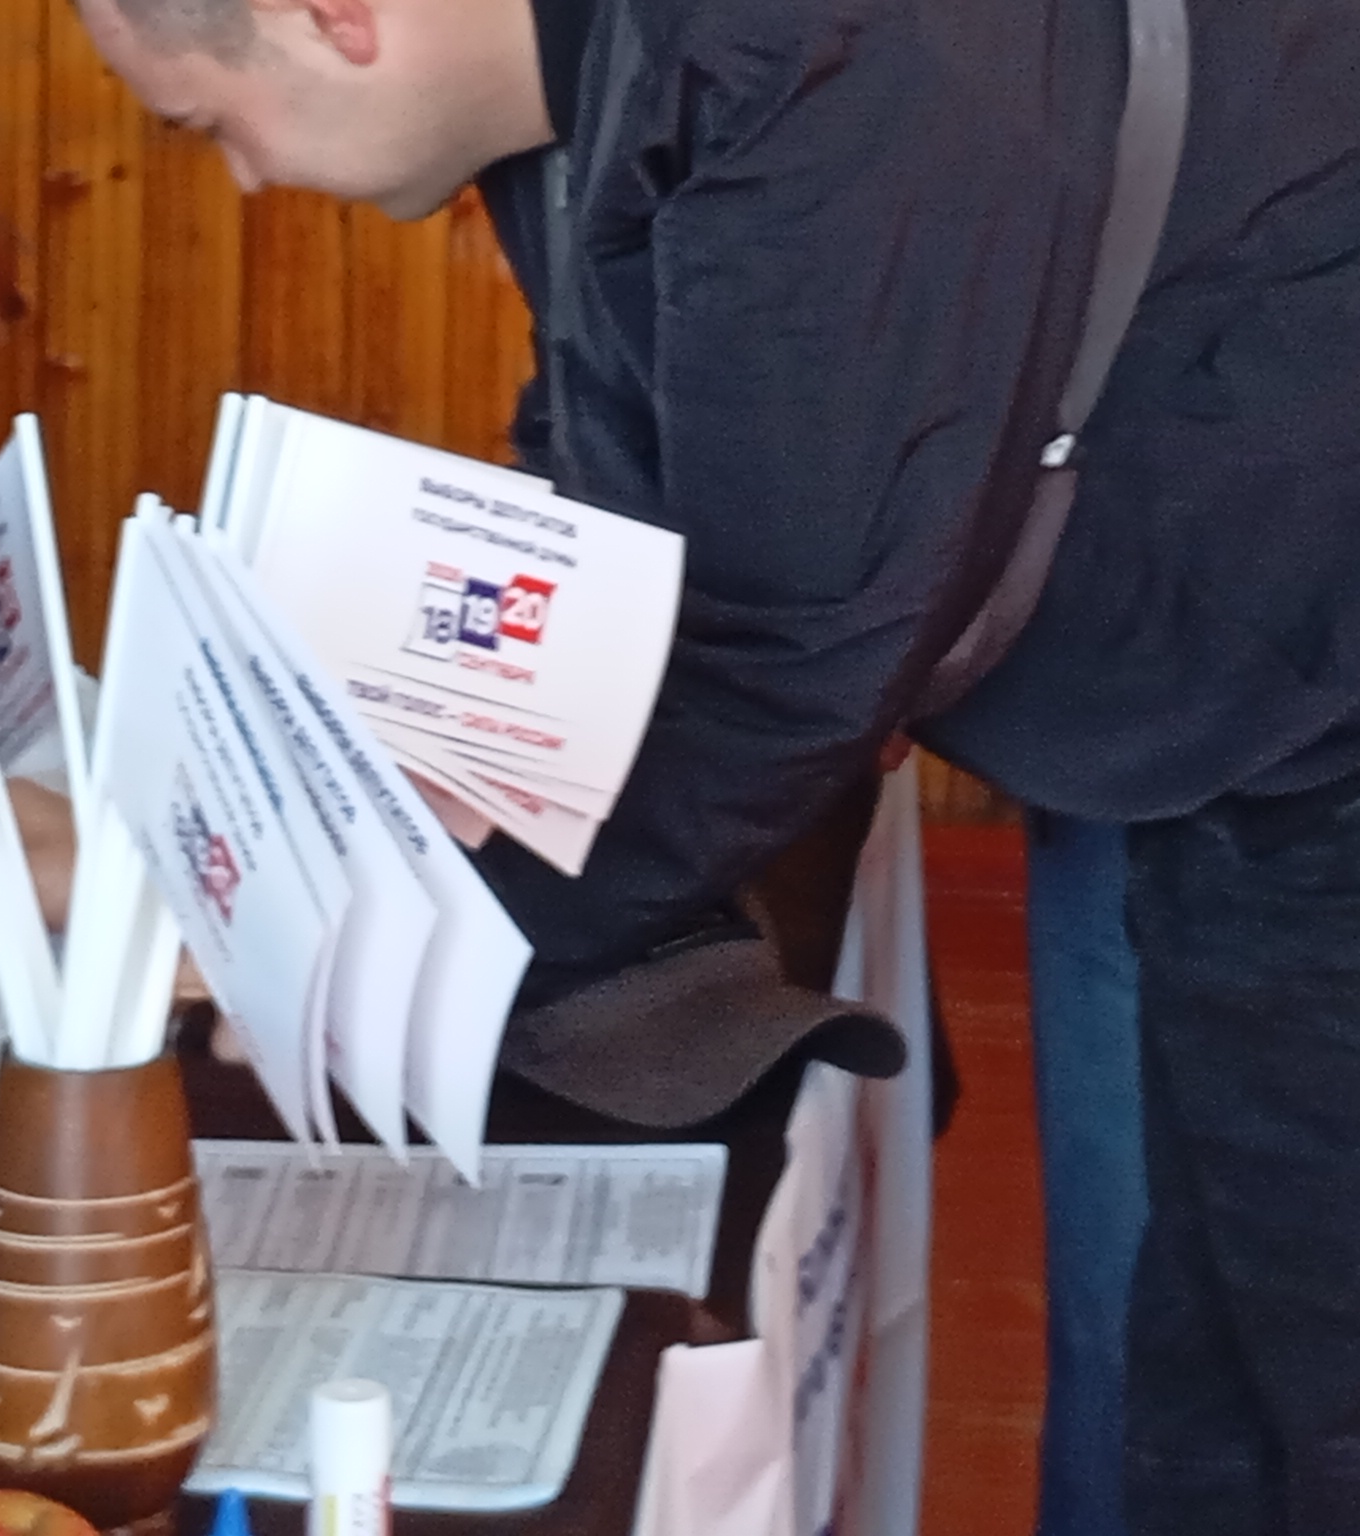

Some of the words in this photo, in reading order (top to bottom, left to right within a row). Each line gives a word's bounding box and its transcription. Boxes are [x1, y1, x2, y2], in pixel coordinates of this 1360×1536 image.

[421, 605, 460, 644] 18
[463, 593, 500, 636] 19
[499, 586, 546, 631] 20
